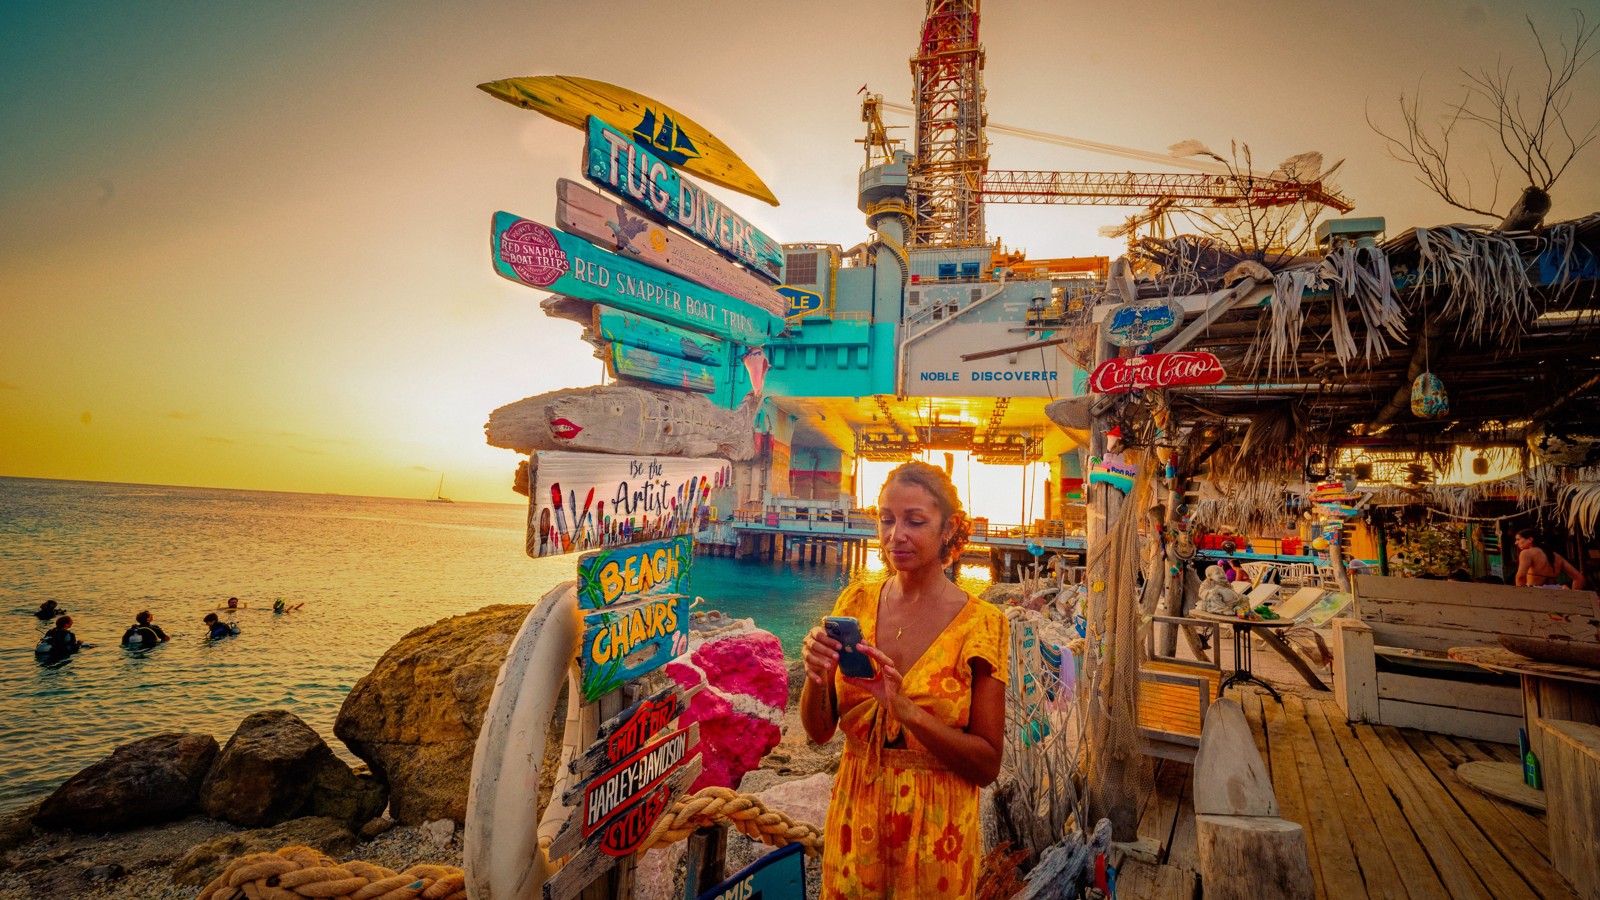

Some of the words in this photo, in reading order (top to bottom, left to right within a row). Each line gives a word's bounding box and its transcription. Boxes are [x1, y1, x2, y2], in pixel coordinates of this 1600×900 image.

[602, 128, 670, 212] TUG
[678, 177, 757, 263] DIVERS
[501, 240, 520, 253] RED
[522, 245, 567, 260] SNAPPER
[510, 253, 532, 265] BOAT
[536, 256, 569, 270] TRIPS
[574, 257, 610, 288] RED
[615, 273, 682, 311] SNAPPER
[686, 296, 716, 321] BOAT
[721, 308, 753, 333] TRIPS
[786, 295, 809, 309] LE
[920, 371, 960, 382] NOBLE
[971, 371, 1058, 382] DISCOVERER
[630, 459, 645, 479] Be
[648, 458, 664, 480] the
[611, 480, 671, 516] Artist
[599, 544, 680, 604] BEACH
[592, 599, 677, 665] CHAIRS
[617, 704, 669, 760] MOTOR
[587, 732, 687, 827] HARLEY-DAVIDSON
[609, 790, 662, 848] CYCLES
